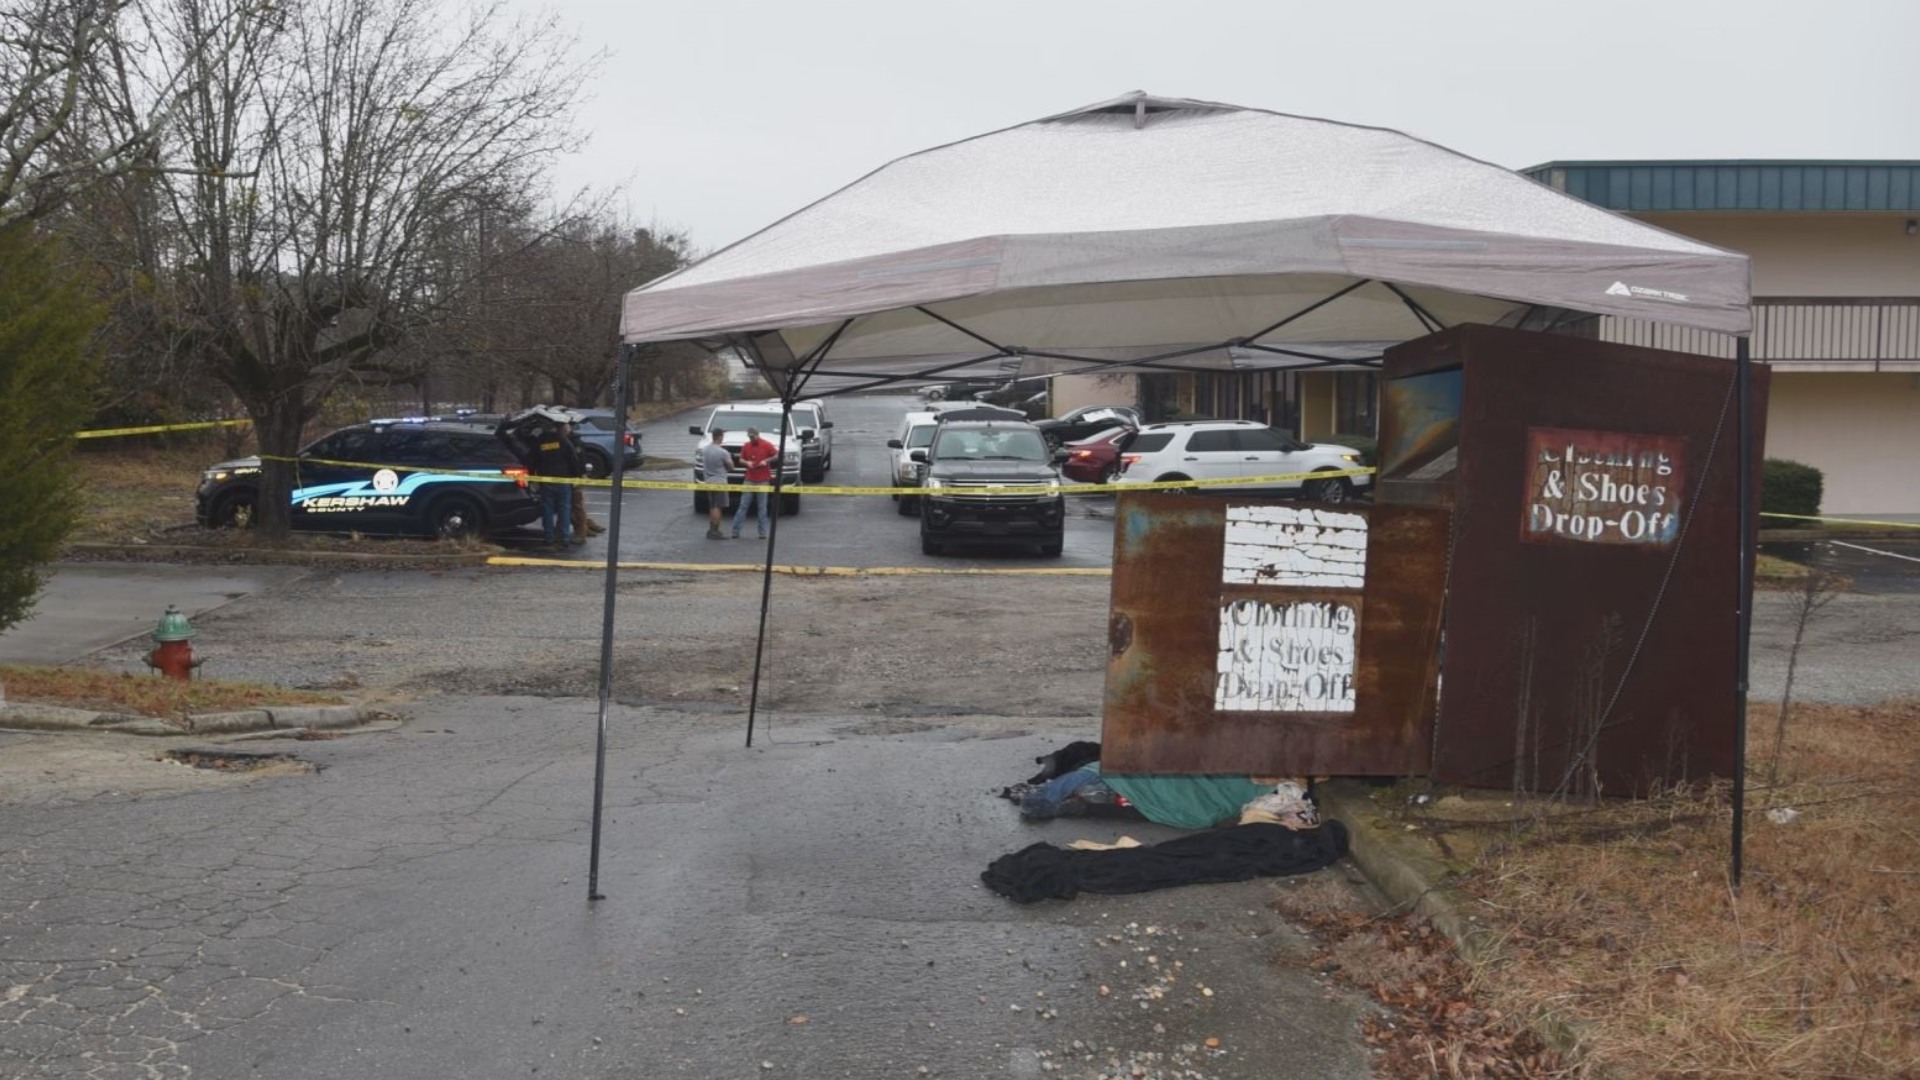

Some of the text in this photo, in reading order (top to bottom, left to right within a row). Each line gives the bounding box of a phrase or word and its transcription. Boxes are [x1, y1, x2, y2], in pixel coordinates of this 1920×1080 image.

[302, 496, 410, 507] KERSHAW
[1543, 470, 1666, 506] & Shoes
[1530, 504, 1675, 540] Drop-Off
[1234, 637, 1344, 666] & Shoes
